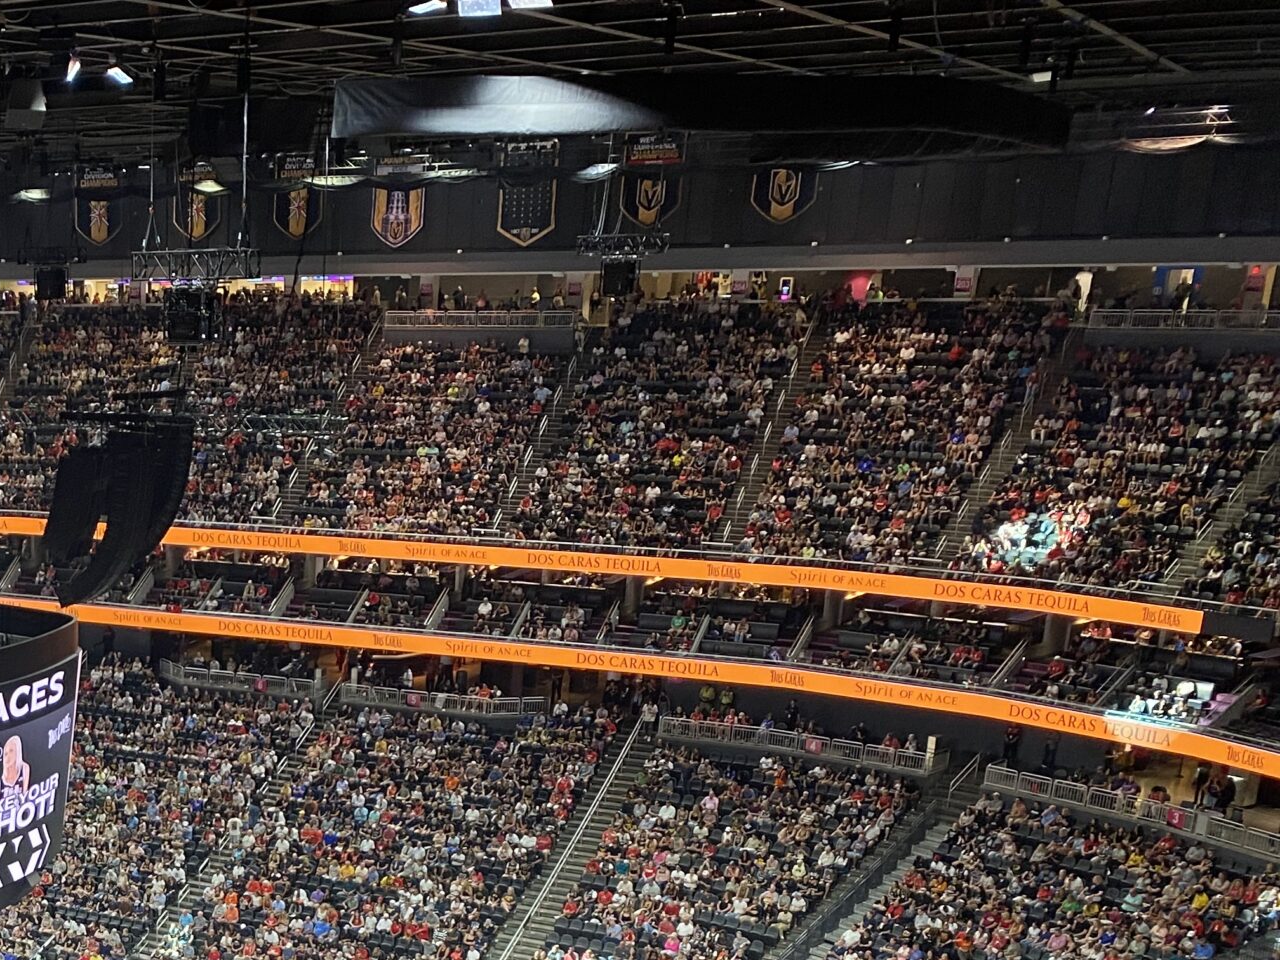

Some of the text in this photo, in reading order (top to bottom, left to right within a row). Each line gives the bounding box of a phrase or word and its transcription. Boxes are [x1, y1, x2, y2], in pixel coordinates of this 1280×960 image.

[192, 532, 301, 548] DOS CARAS TEQUILA
[470, 551, 487, 559] ACE
[527, 553, 661, 572] DOS CARAS TEQUILA
[832, 575, 845, 584] OF
[849, 577, 864, 586] AN
[865, 578, 887, 588] ACE
[934, 583, 1090, 613] DOS CARAS TEQUILA
[218, 621, 333, 640] DOS CARAS TEQUILA
[515, 649, 532, 657] ACE
[576, 653, 719, 677] DOS CARAS TEQUILA
[899, 690, 913, 698] OF
[919, 692, 934, 701] AN
[935, 695, 958, 705] ACE
[1009, 704, 1171, 746] DOS CARAS TEQUILA
[19, 772, 60, 803] YOUR
